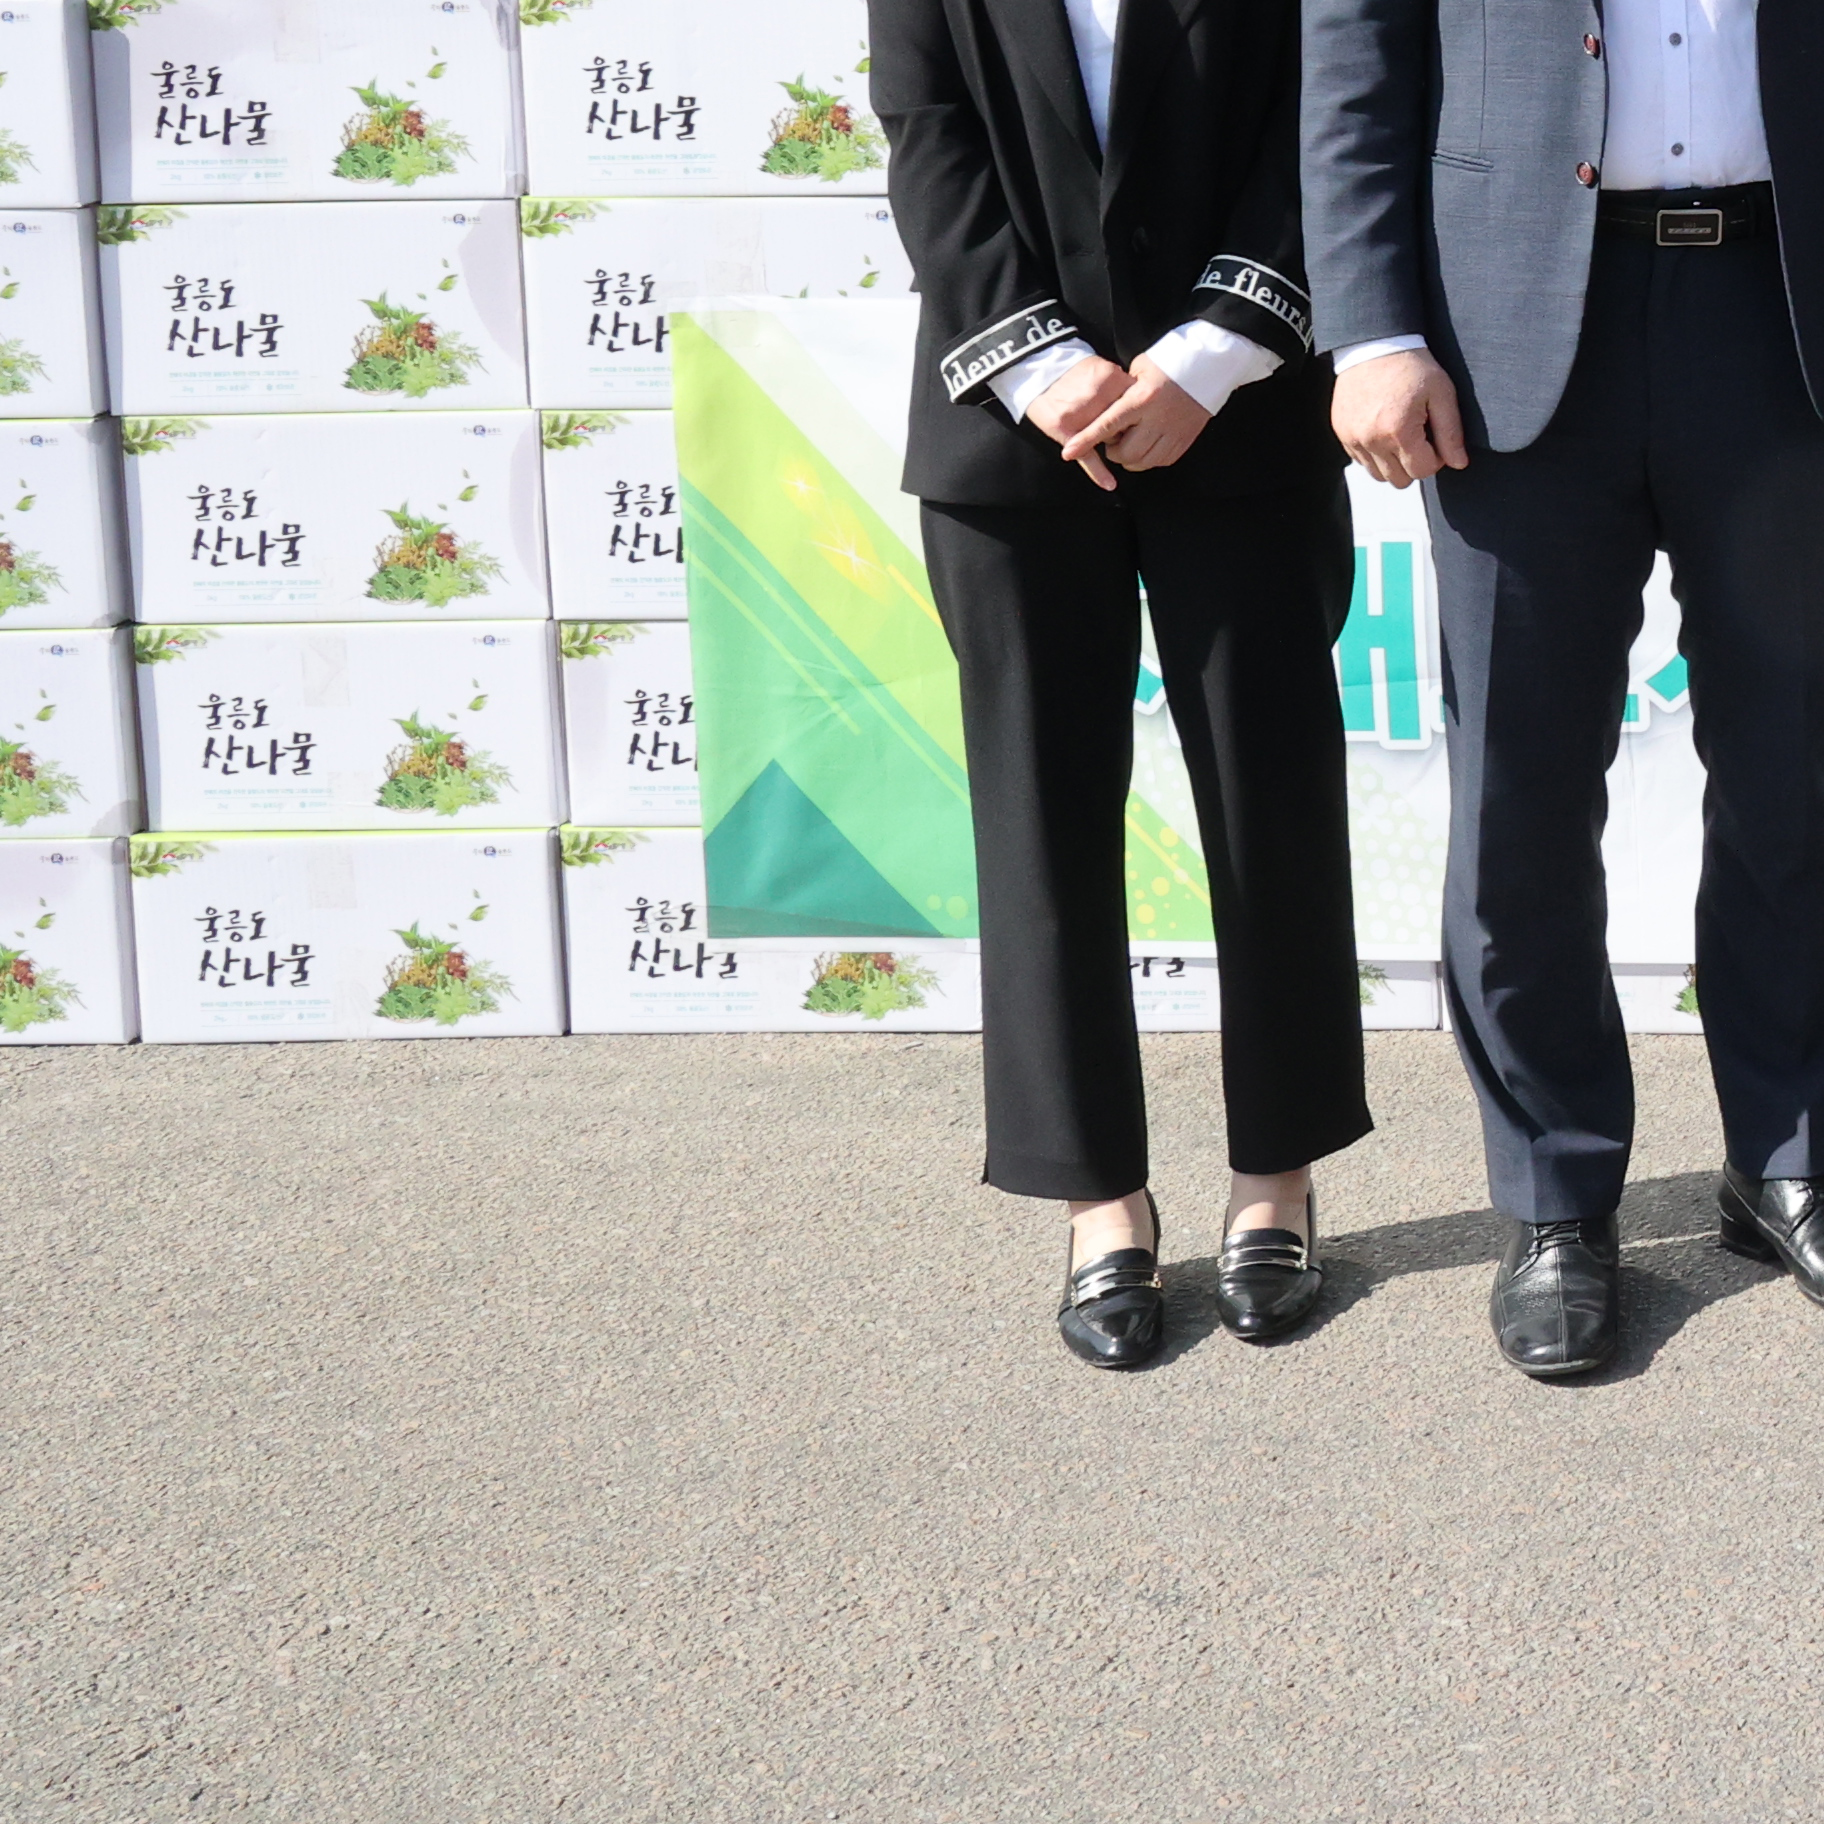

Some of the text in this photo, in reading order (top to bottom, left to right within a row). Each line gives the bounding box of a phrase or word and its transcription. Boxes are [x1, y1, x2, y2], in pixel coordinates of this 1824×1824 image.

[151, 61, 222, 99] 울릉도
[584, 57, 652, 93] 울릉도
[156, 101, 271, 145] 산나물
[588, 96, 699, 140] 산나물
[164, 275, 234, 311] 울릉도
[586, 269, 655, 306] 울릉도
[1234, 267, 1306, 333] fleurs
[169, 314, 282, 357] 산나물
[589, 312, 668, 352] 산나
[1026, 315, 1065, 346] de
[189, 485, 257, 521] 울릉도
[607, 481, 675, 517] 울릉도
[193, 524, 305, 566] 산나물
[610, 523, 683, 563] 산나
[199, 694, 268, 730] 울릉도
[204, 733, 314, 775] 산나물
[196, 907, 266, 942] 울릉도
[627, 897, 695, 933] 울릉도
[200, 945, 313, 987] 산나물
